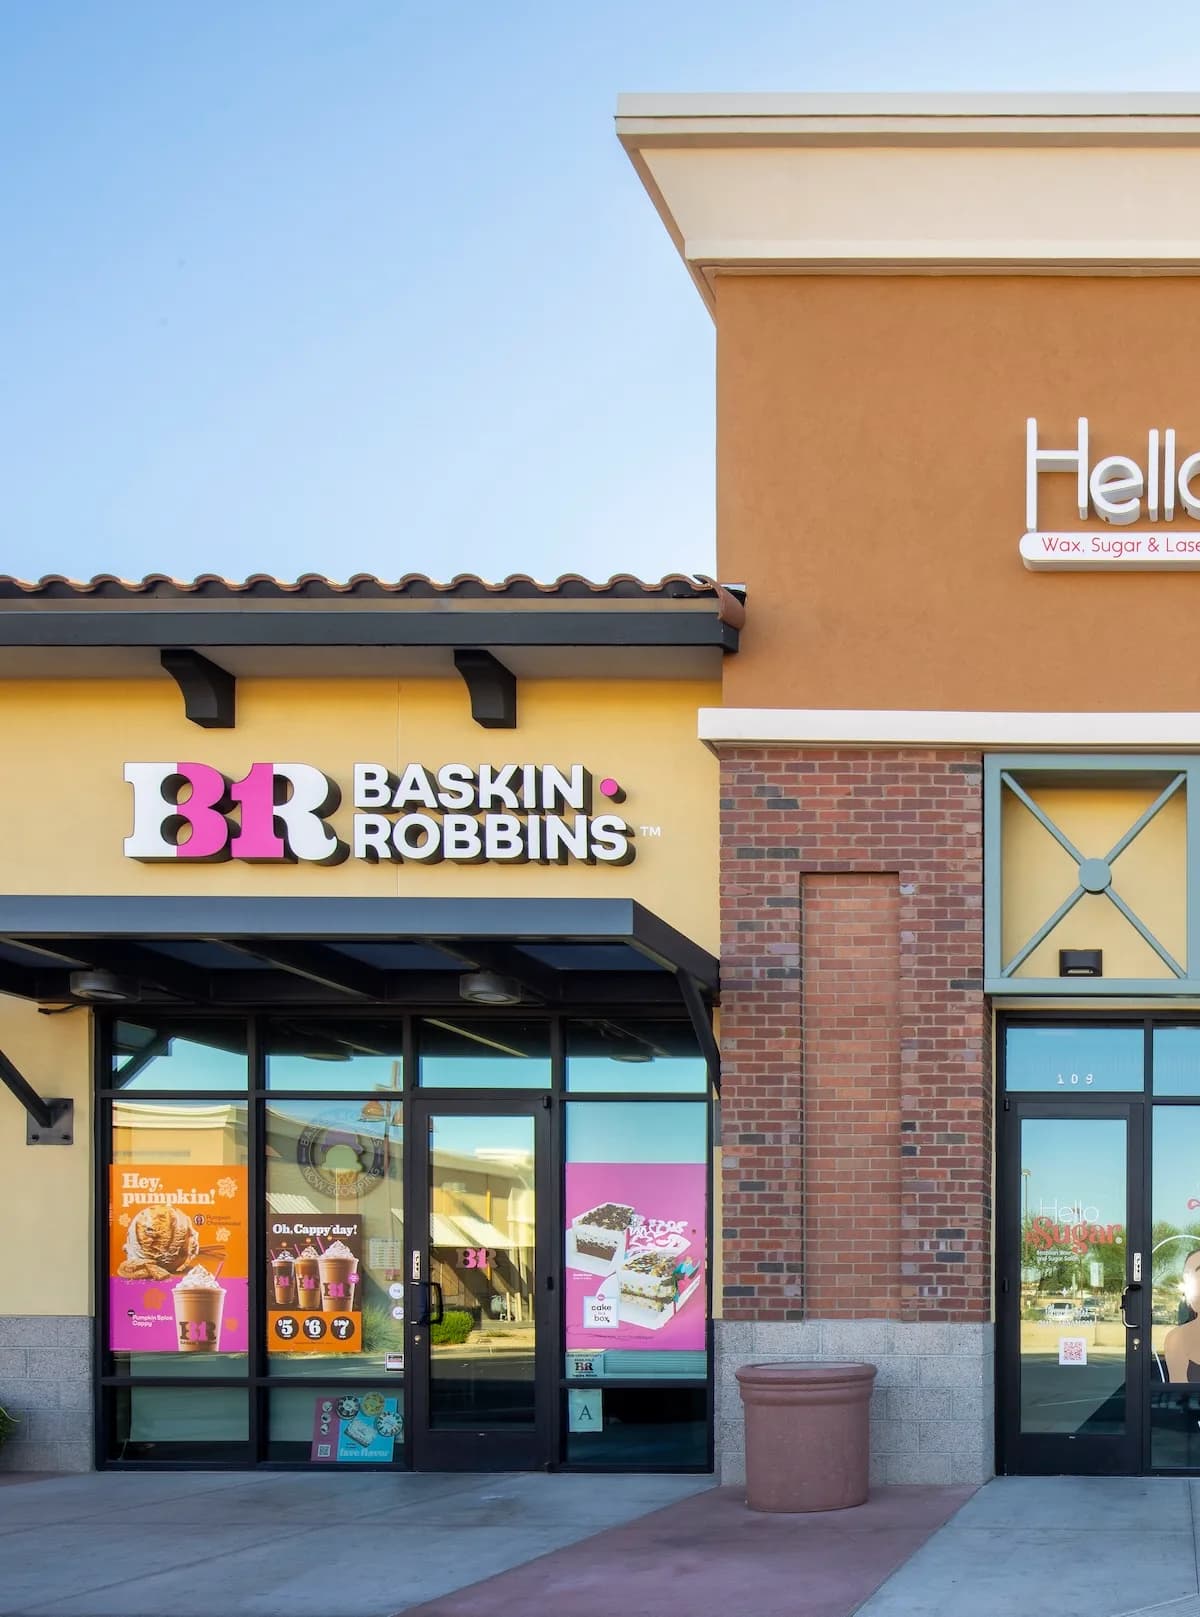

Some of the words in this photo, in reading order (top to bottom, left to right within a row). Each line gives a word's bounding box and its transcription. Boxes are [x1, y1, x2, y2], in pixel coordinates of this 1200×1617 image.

[1091, 537, 1142, 558] Sugar
[1147, 538, 1160, 553] &
[353, 763, 586, 810] BASKIN
[353, 813, 629, 861] ROBBINS
[122, 1173, 163, 1192] Hey,
[122, 1188, 216, 1208] pumpkin!
[1040, 1199, 1099, 1225] Hello
[293, 1223, 332, 1237] Cappy
[332, 1224, 358, 1237] day!
[1025, 1216, 1122, 1255] Sugar
[132, 1314, 156, 1322] Pumpkin
[132, 1320, 153, 1328] Cappy
[594, 1314, 609, 1322] box
[575, 1362, 594, 1371] BR
[578, 1404, 593, 1420] A
